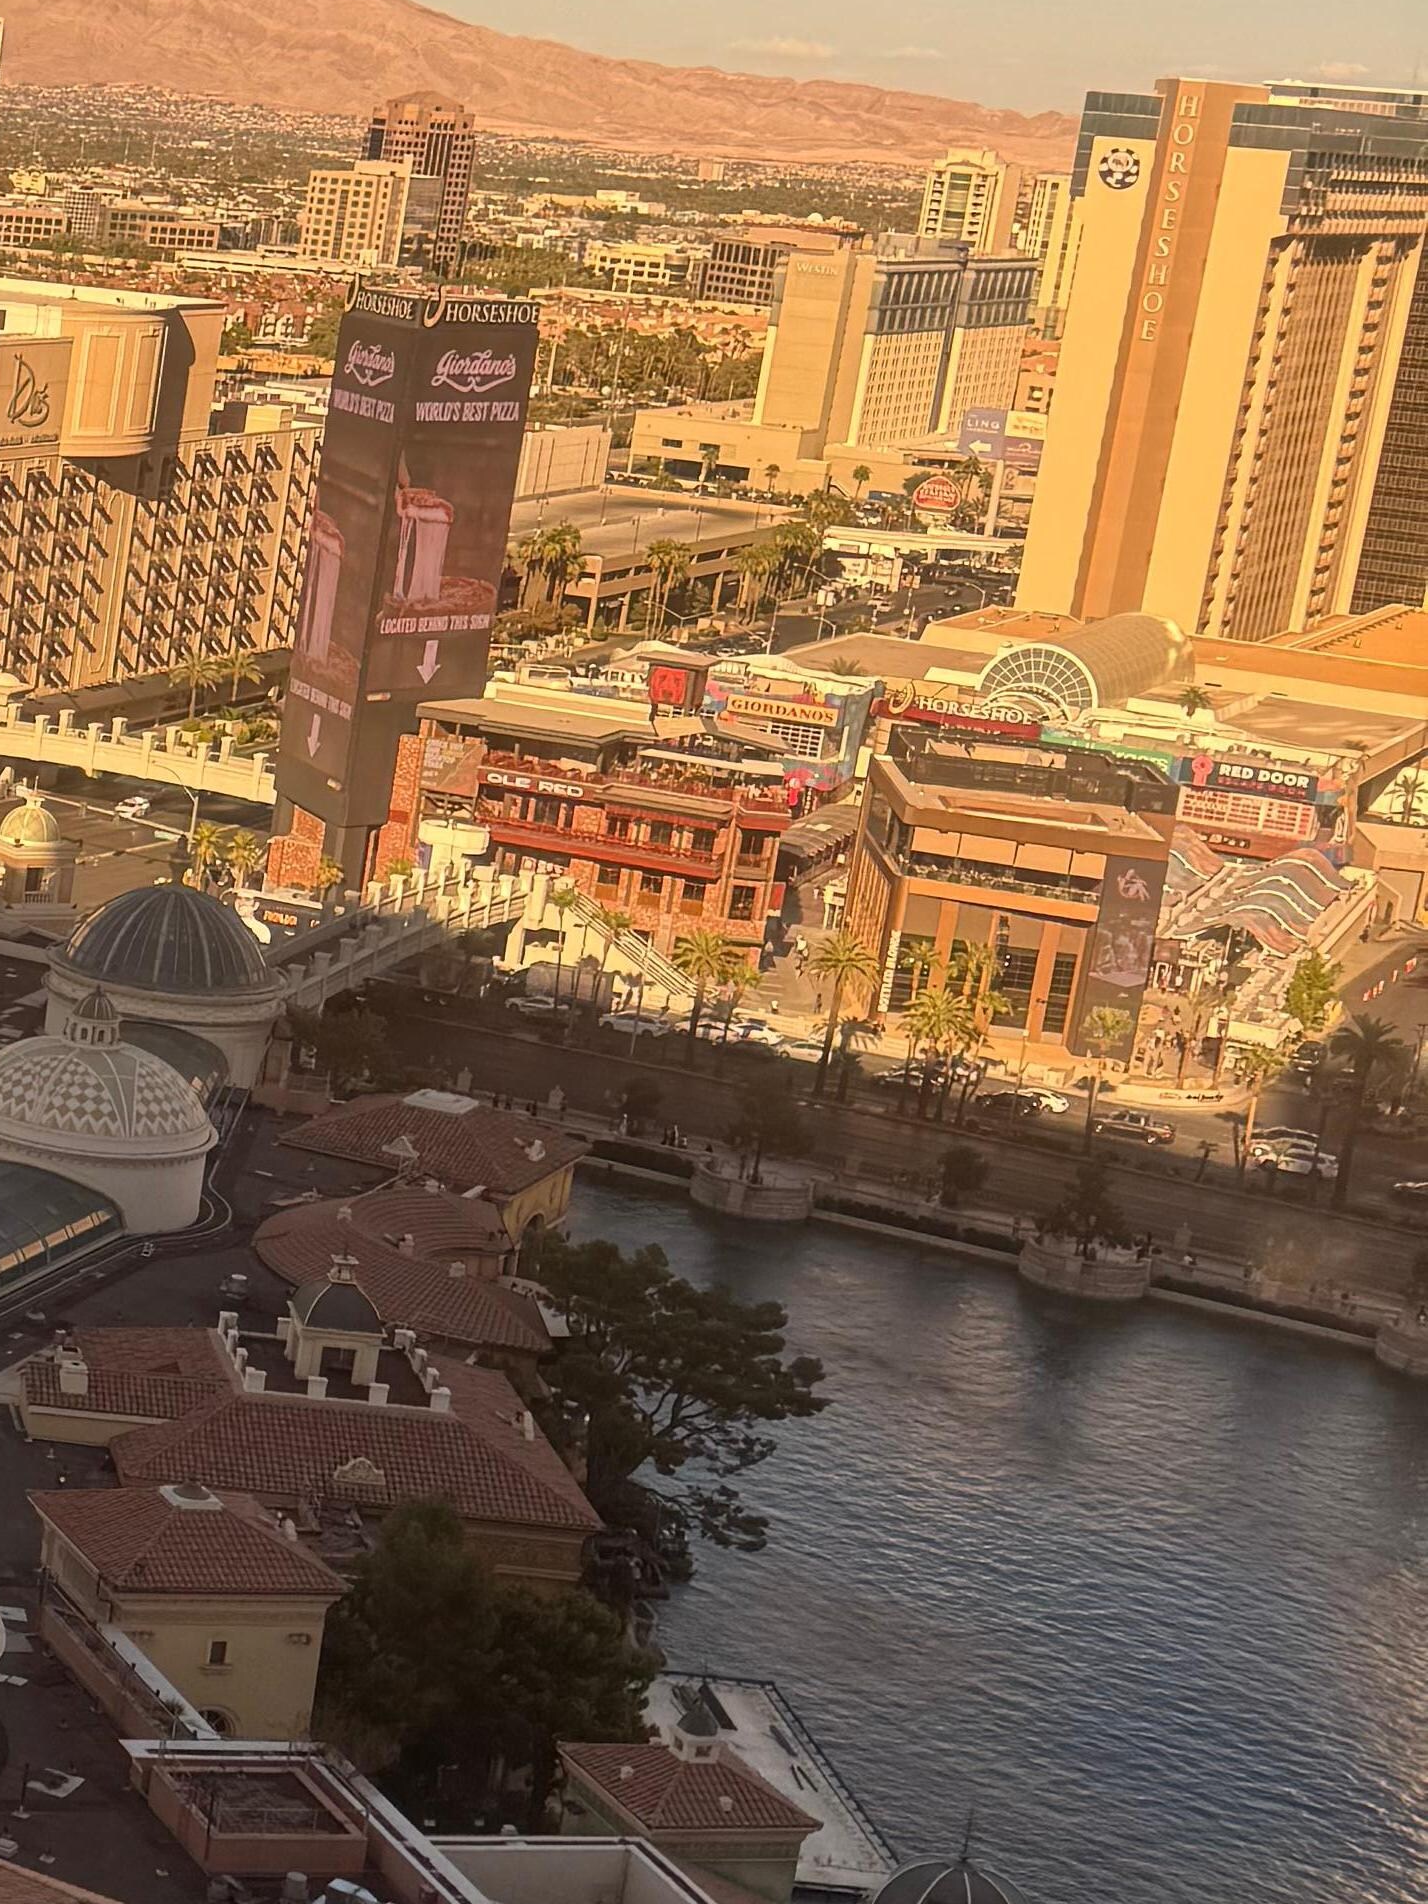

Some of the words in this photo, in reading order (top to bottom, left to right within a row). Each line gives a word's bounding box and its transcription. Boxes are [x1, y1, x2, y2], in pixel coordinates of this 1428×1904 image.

[1140, 94, 1200, 342] HORSESHOE
[356, 291, 414, 321] HORSESHOE
[445, 301, 539, 325] HORSESHOE
[431, 348, 517, 393] Giordano's
[415, 401, 461, 422] WORLD'S
[462, 401, 490, 422] BEST
[489, 401, 520, 422] PIZZA
[731, 698, 834, 724] GIORDANO'S
[917, 695, 1034, 726] HORSESHOE
[1218, 763, 1254, 780] RED
[1257, 769, 1310, 789] DOOR
[538, 781, 584, 798] RED
